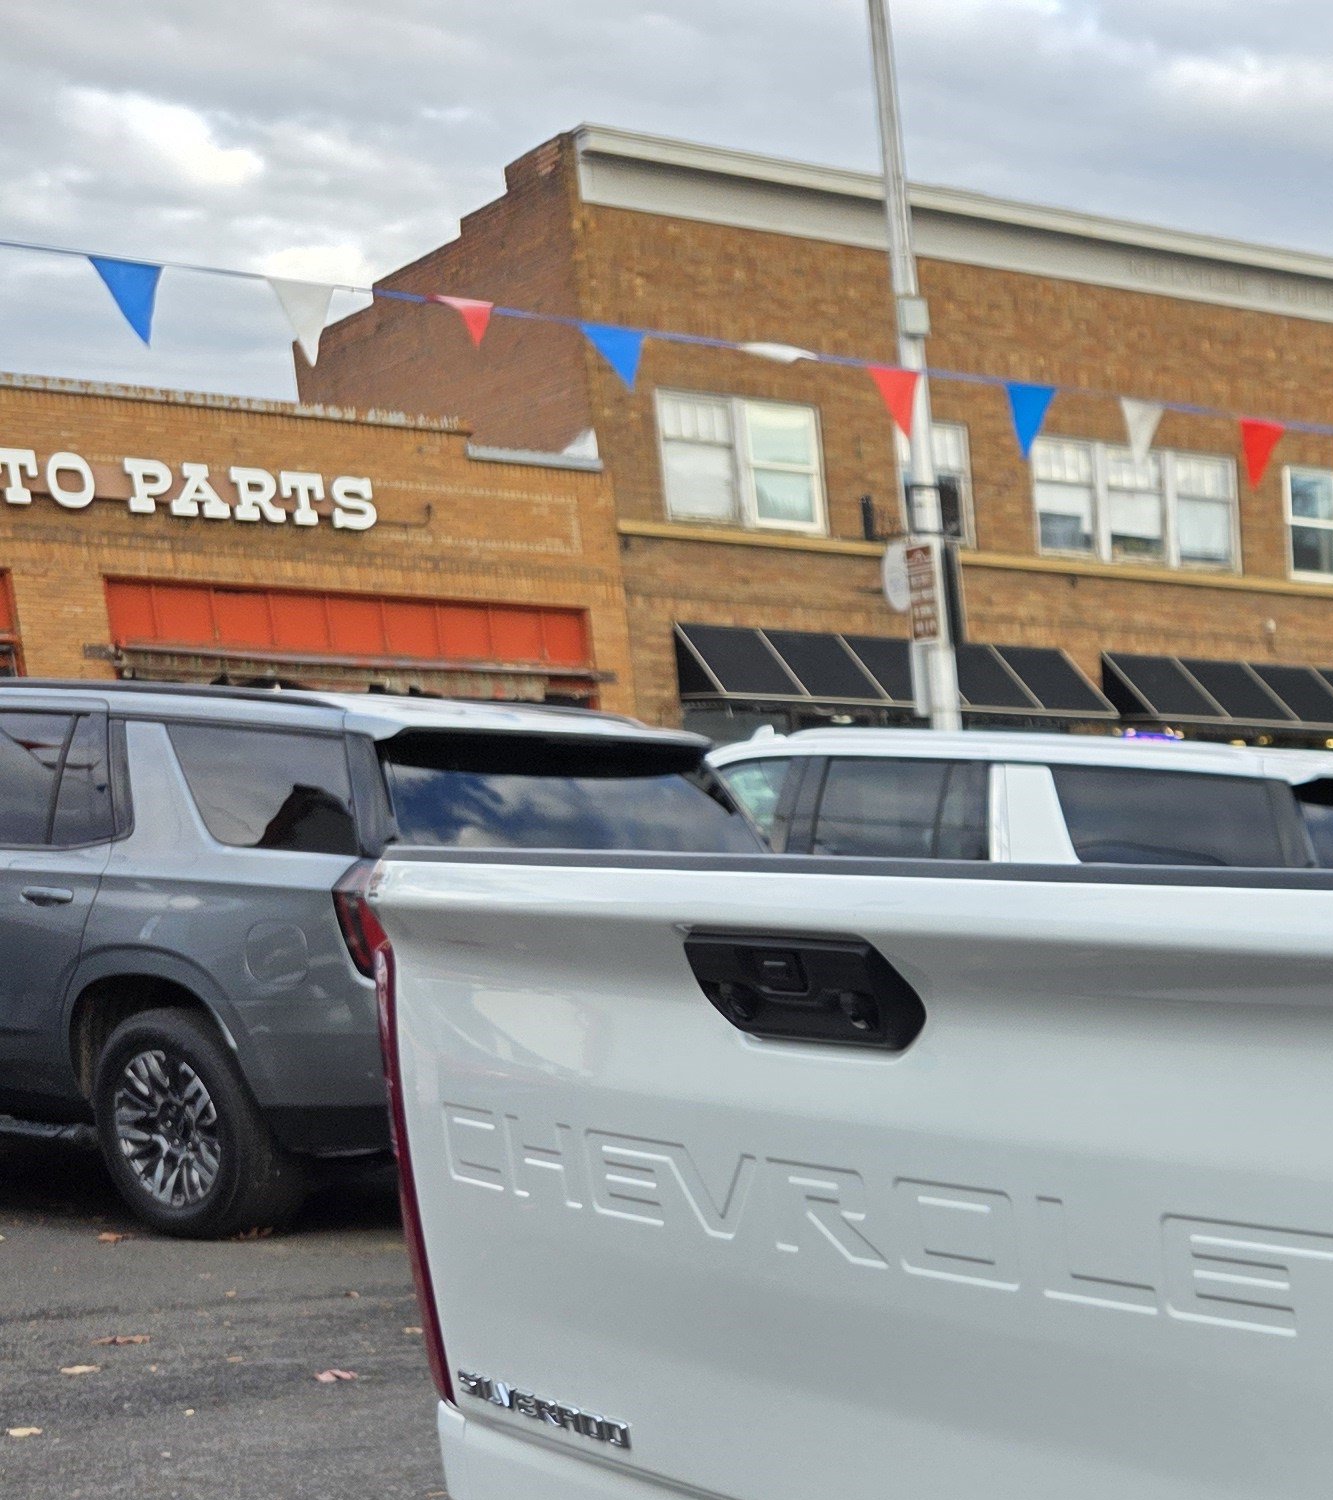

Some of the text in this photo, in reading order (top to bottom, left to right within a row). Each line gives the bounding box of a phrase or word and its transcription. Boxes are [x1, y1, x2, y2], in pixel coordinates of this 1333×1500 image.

[0, 447, 378, 531] TO PARTS
[457, 1369, 632, 1450] SILVERADO
